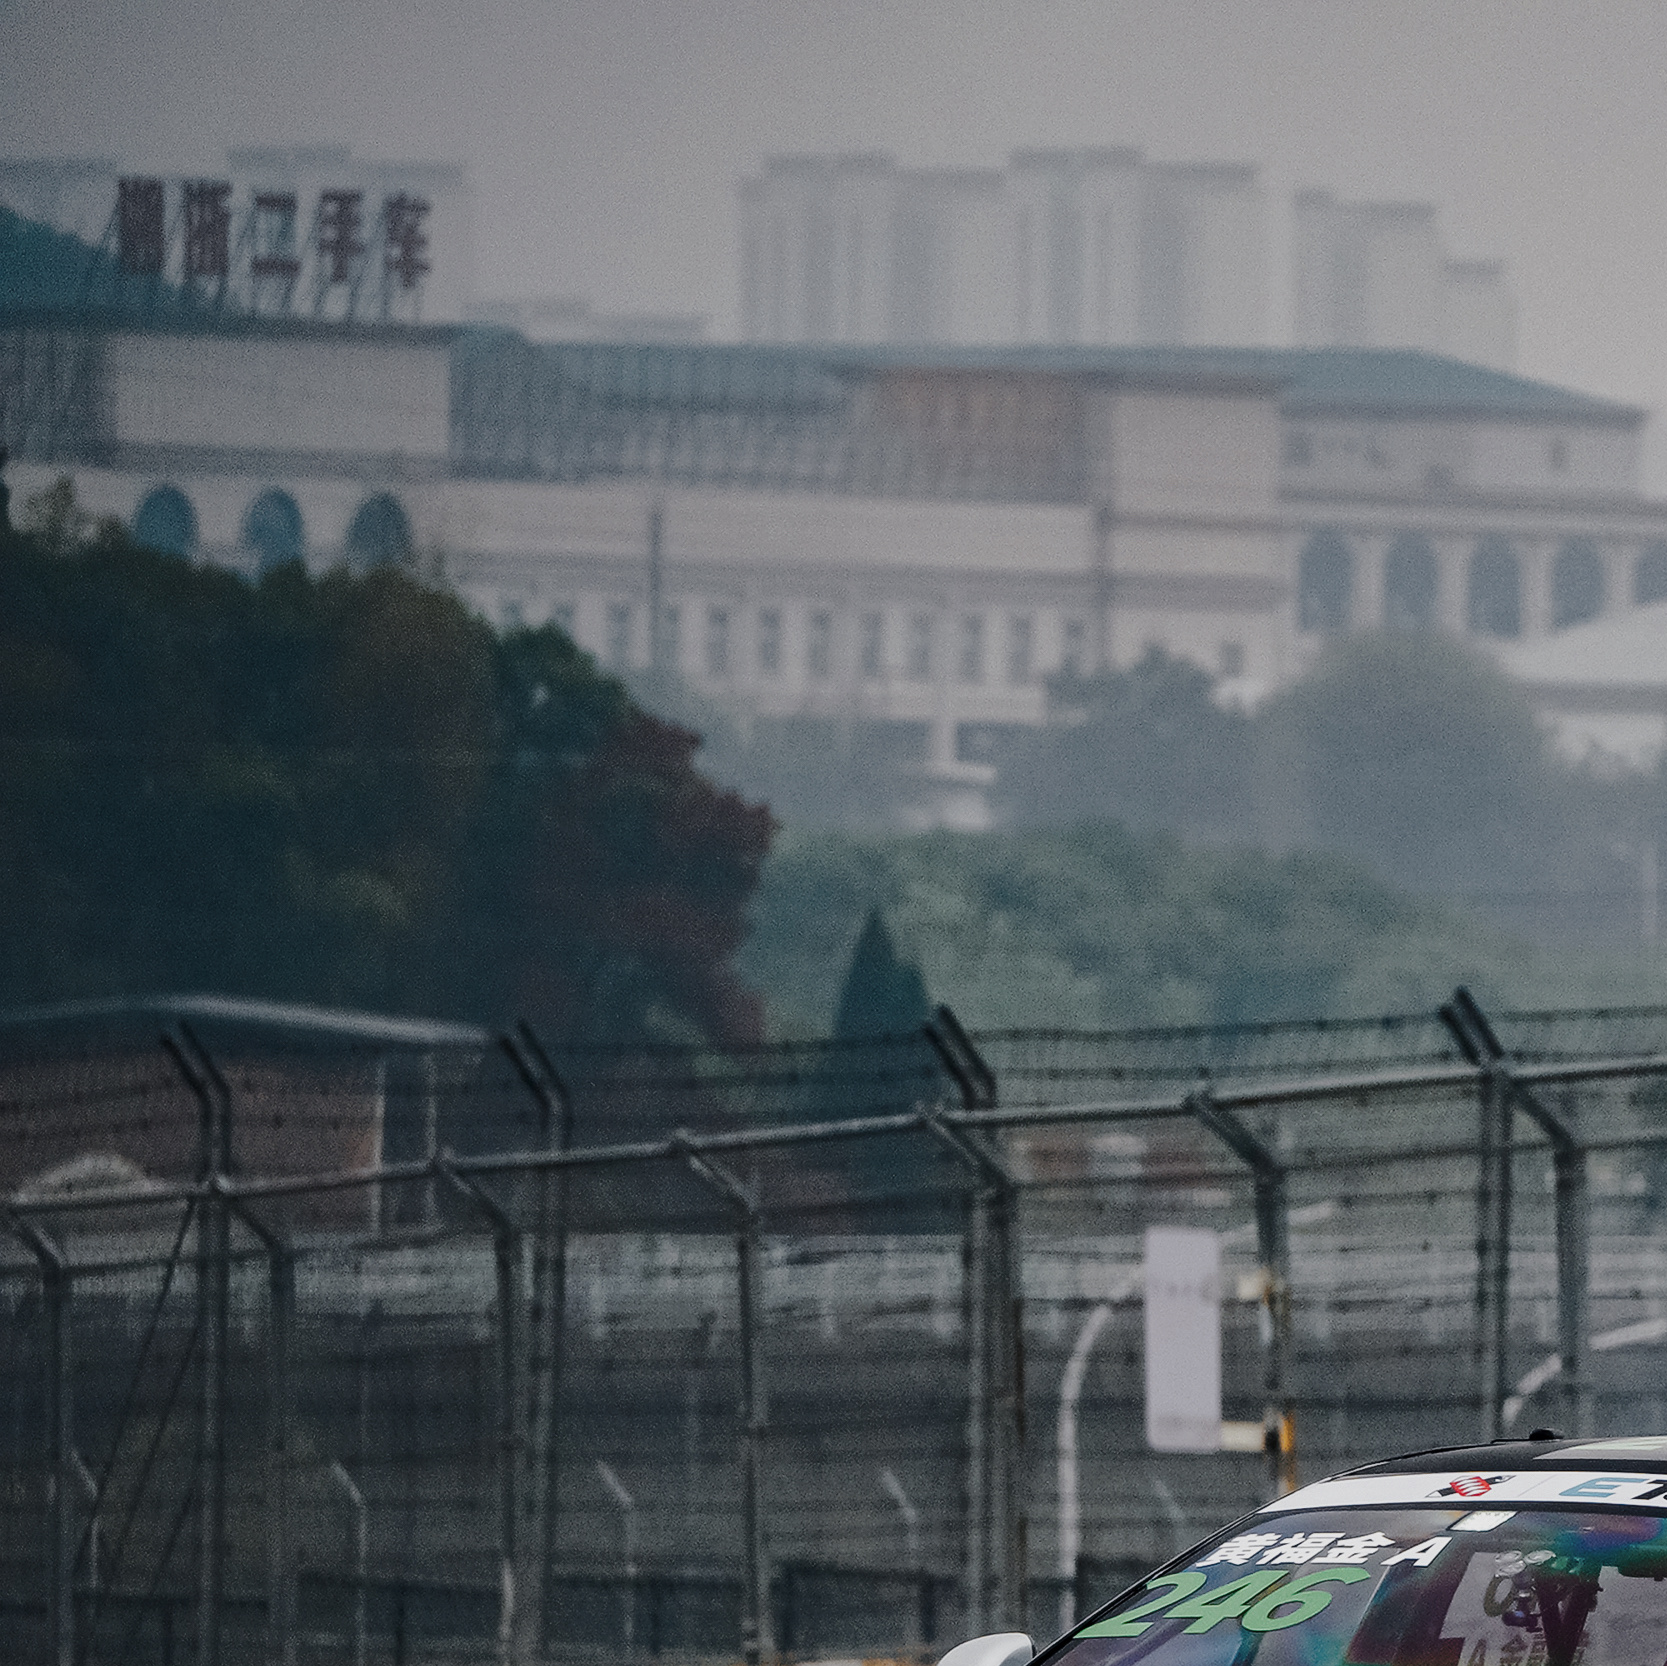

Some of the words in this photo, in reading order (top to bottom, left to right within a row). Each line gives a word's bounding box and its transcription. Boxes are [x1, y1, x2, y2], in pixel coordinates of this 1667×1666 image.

[1196, 1531, 1396, 1568] 黄福金
[1380, 1536, 1453, 1567] A
[1072, 1567, 1372, 1640] 246
